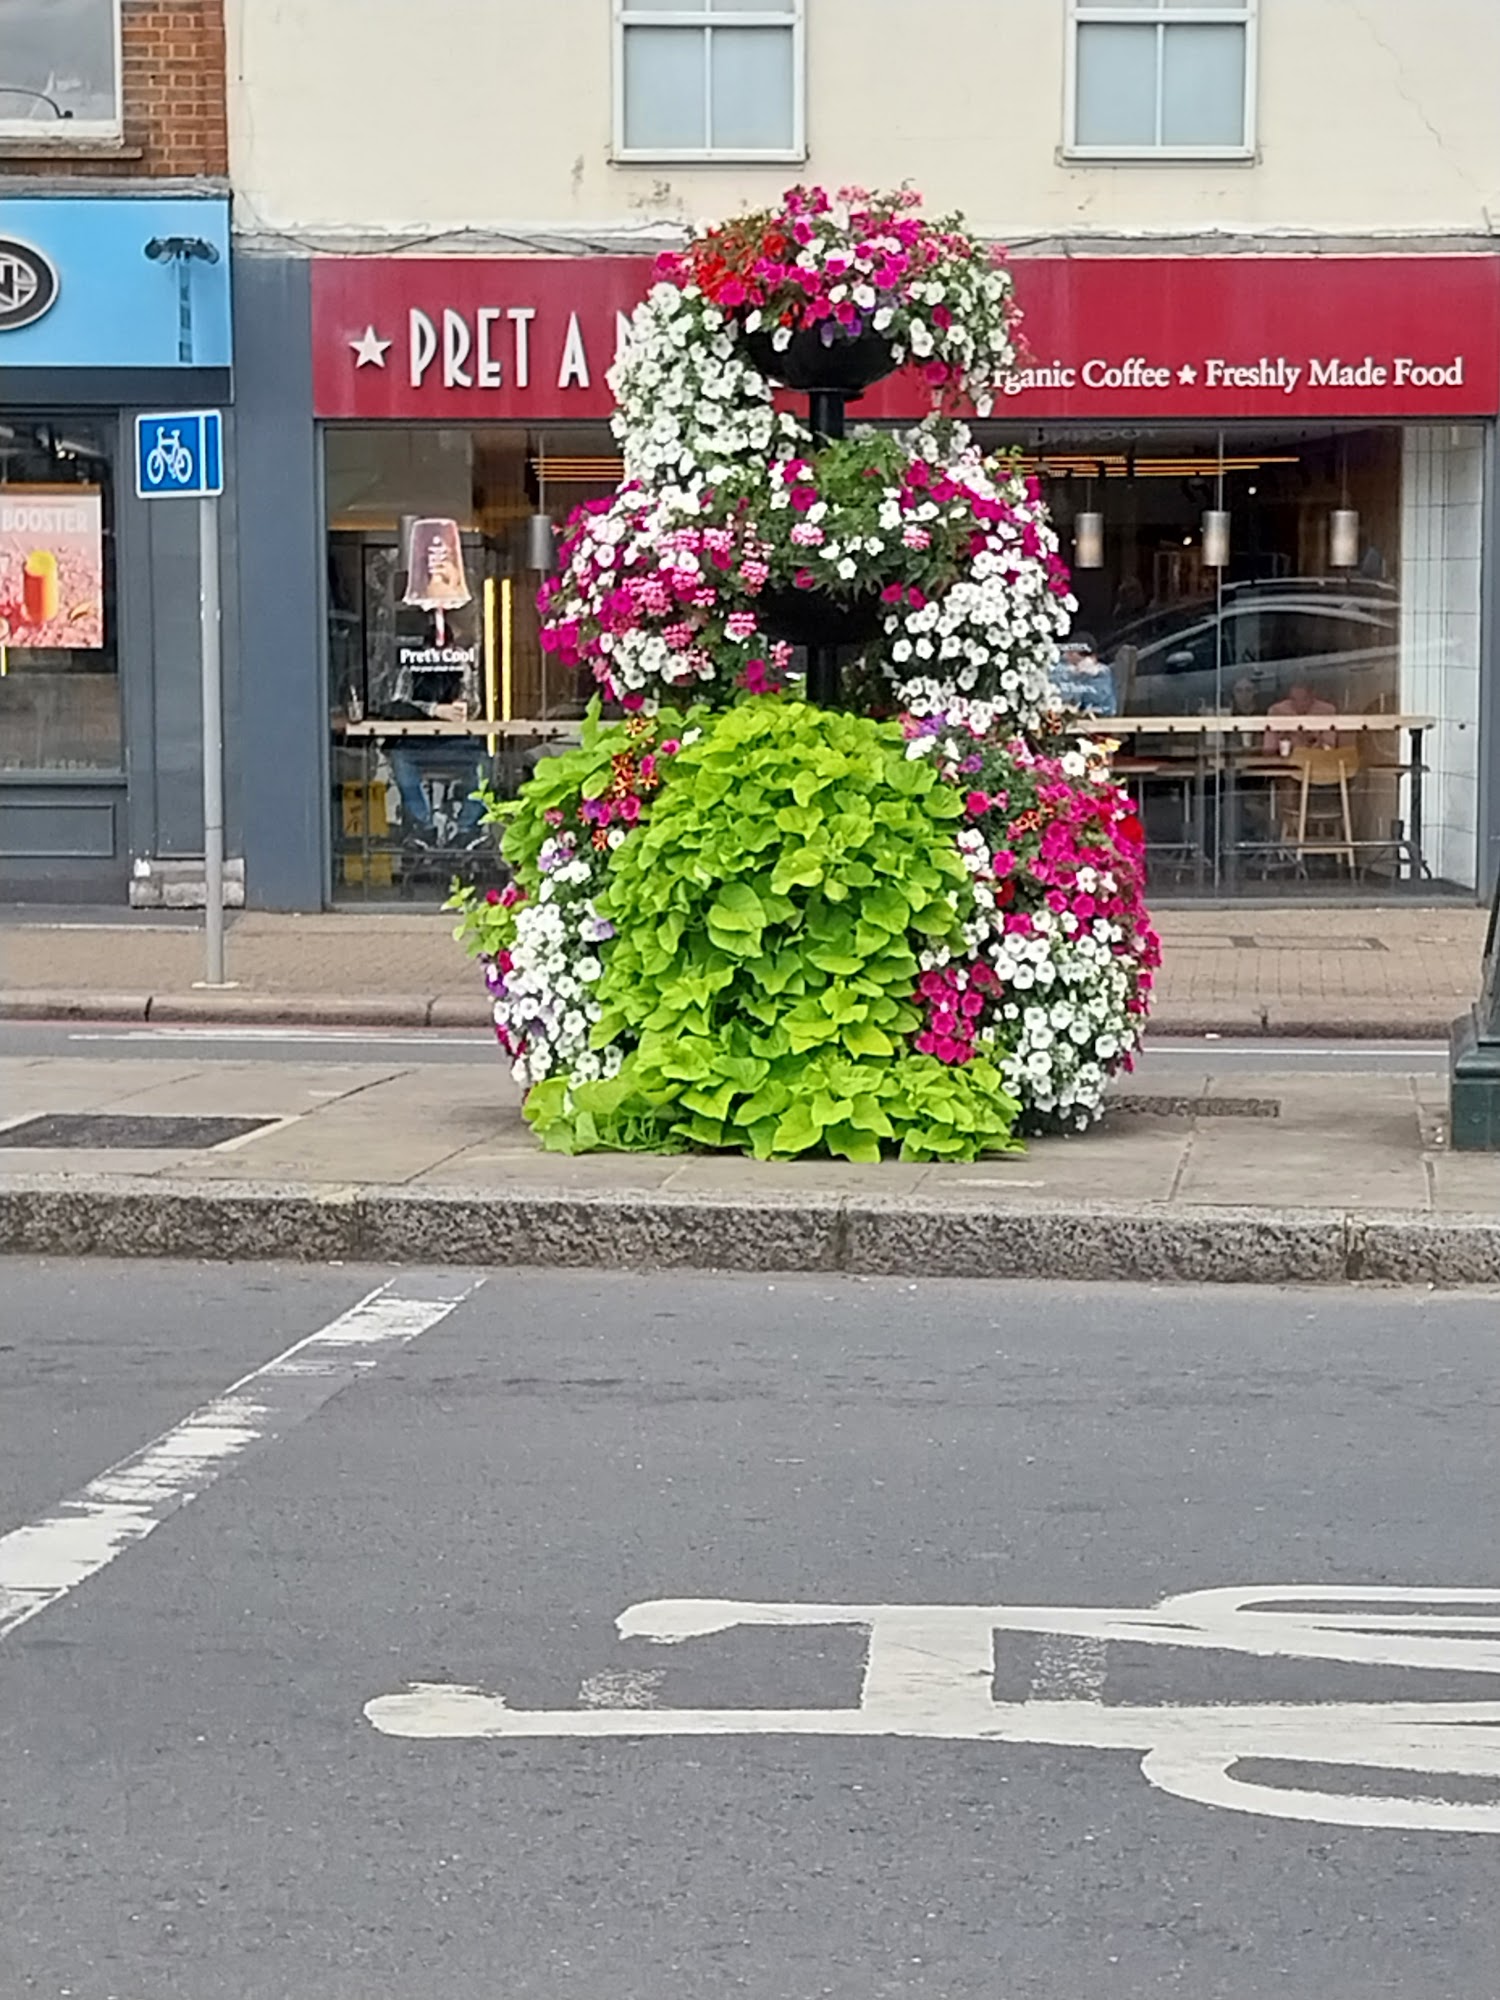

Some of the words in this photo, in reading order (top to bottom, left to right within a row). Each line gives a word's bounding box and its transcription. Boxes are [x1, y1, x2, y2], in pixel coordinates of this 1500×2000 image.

[409, 308, 536, 388] PRET
[557, 310, 590, 388] A
[992, 360, 1076, 395] rganic
[1081, 357, 1171, 388] Coffee
[1204, 357, 1302, 394] Freshly
[1306, 357, 1387, 387] Made
[1392, 356, 1464, 386] Food
[2, 507, 89, 534] BOOSTER
[400, 648, 440, 664] Pret's
[442, 648, 474, 663] Cool
